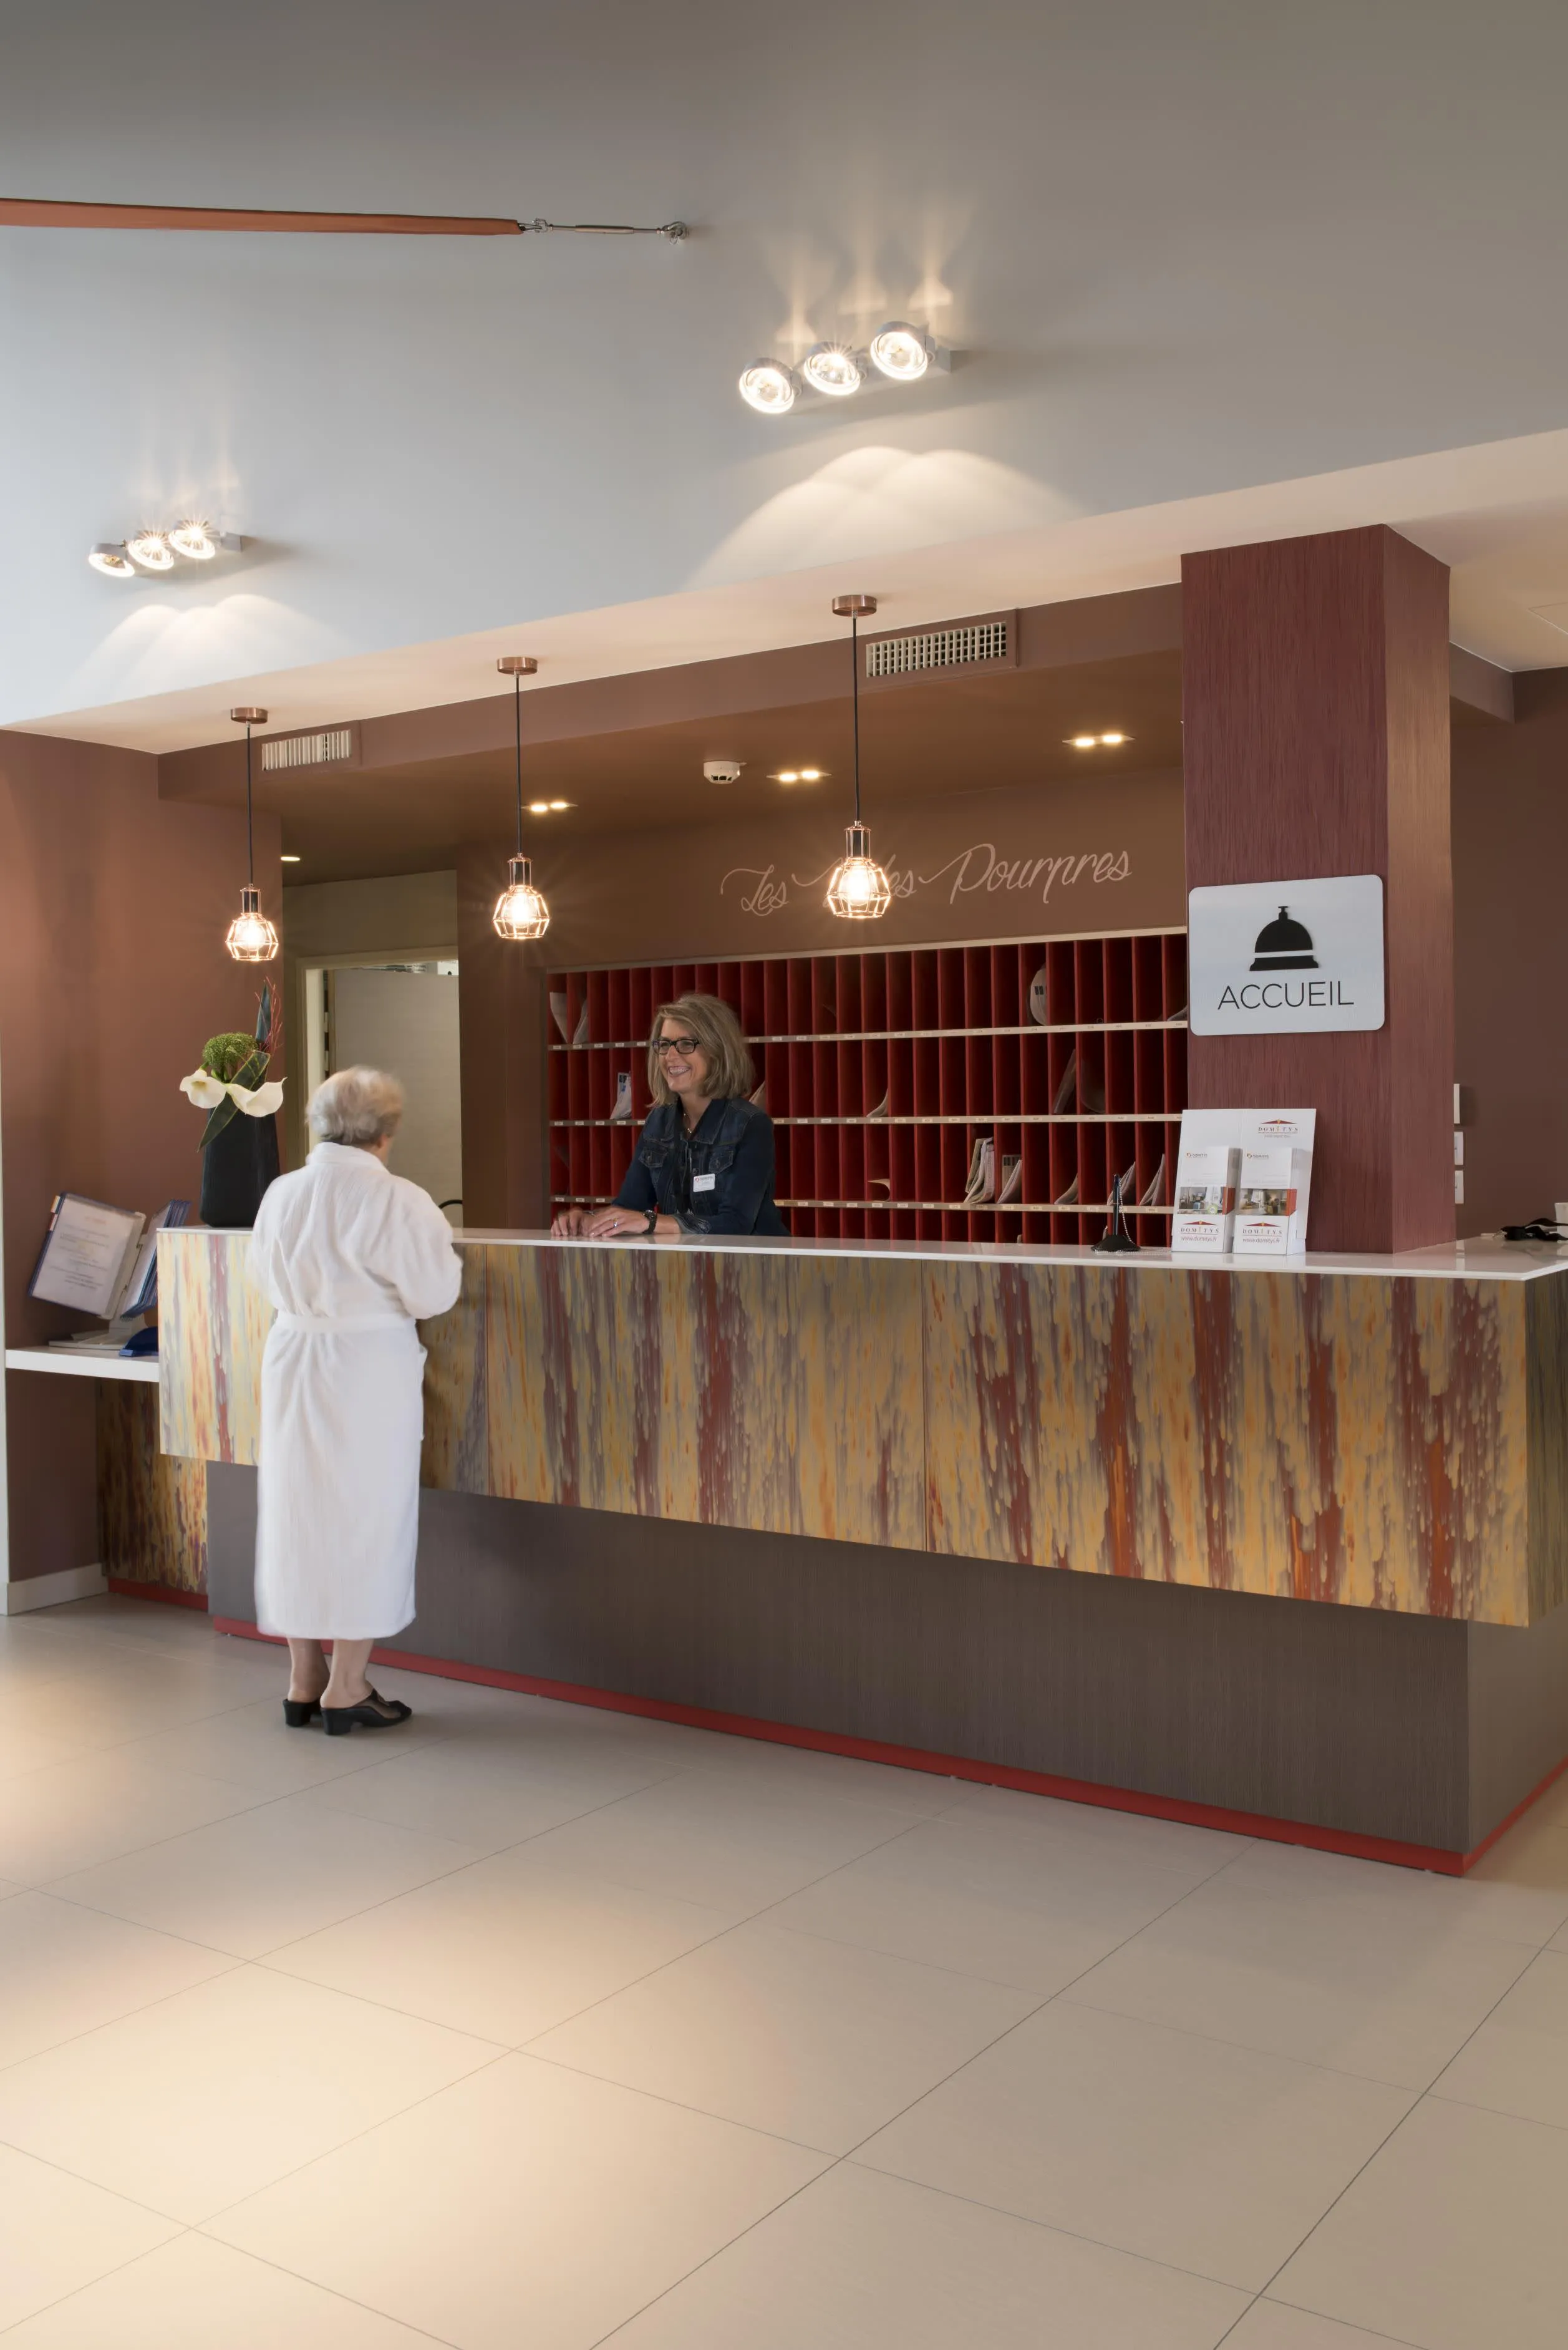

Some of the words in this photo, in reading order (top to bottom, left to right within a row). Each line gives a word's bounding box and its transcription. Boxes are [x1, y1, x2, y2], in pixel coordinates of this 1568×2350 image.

[721, 865, 789, 917] Les
[918, 843, 1133, 905] Pourpres
[1217, 981, 1354, 1010] ACCUEIL
